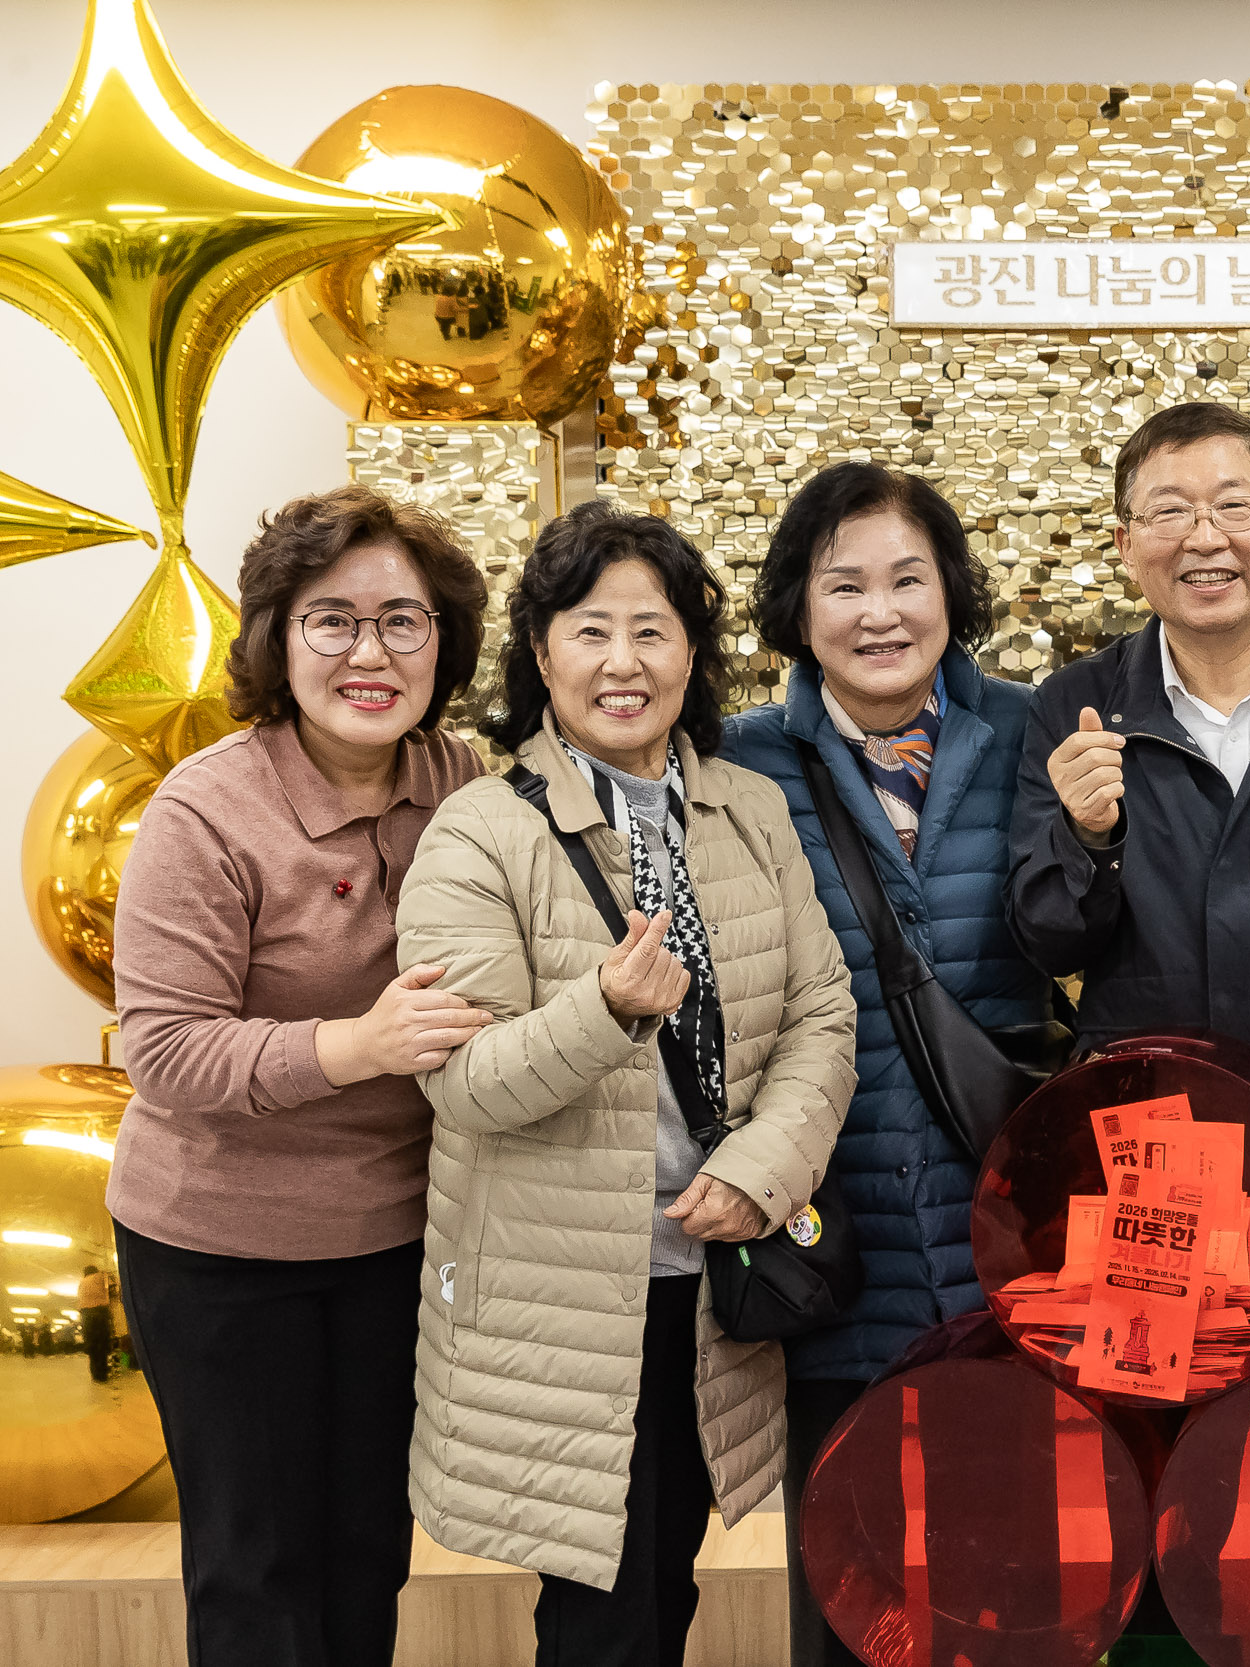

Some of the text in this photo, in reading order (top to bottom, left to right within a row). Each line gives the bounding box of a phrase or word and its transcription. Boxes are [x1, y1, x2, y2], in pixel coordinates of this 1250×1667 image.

[933, 253, 1037, 308] 광진
[1054, 253, 1207, 307] 나눔의
[1110, 1139, 1138, 1153] 2026
[1118, 1203, 1148, 1218] 2026
[1113, 1217, 1196, 1252] 따뜻한
